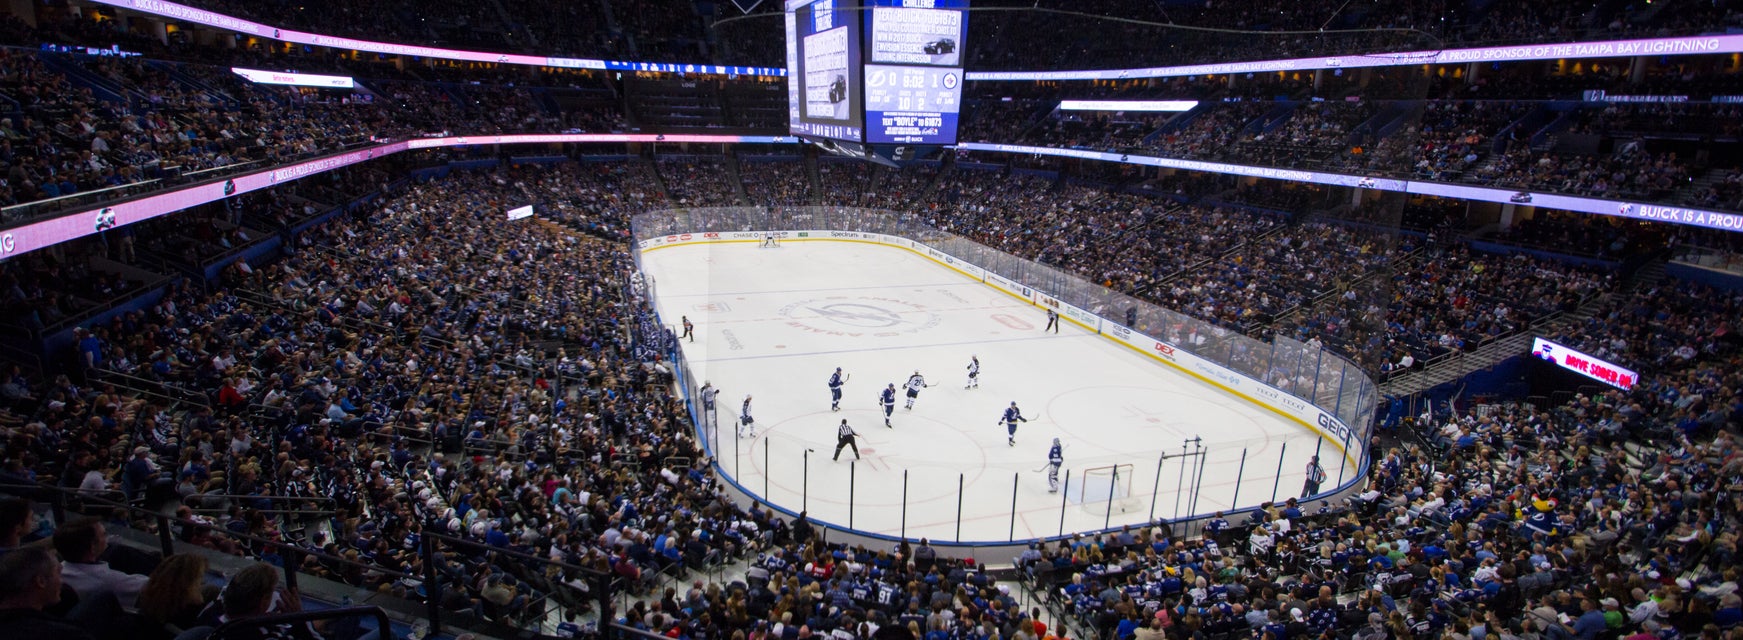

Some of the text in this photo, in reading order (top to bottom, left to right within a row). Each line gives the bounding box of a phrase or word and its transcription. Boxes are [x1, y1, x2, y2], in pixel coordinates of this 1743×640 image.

[878, 10, 894, 22] TEXT
[924, 13, 932, 24] TO
[934, 12, 956, 25] 61873
[936, 26, 949, 34] SHOT
[950, 26, 957, 35] TO
[893, 34, 906, 42] 2017
[901, 44, 922, 53] ESSENCE
[1438, 53, 1446, 61] A
[1449, 50, 1481, 60] PROUD
[1484, 48, 1531, 59] SPONSOR
[1534, 47, 1549, 57] OF
[1552, 45, 1572, 56] THE
[1575, 44, 1613, 55] TAMPA
[1617, 42, 1640, 53] BAY
[1644, 39, 1719, 52] LIGHTNING
[889, 72, 896, 86] 0
[932, 74, 938, 88] 1
[898, 97, 910, 110] 10
[918, 98, 924, 110] 2
[882, 118, 893, 126] TEXT
[925, 117, 942, 127] 61873
[1640, 206, 1680, 220] BUICK
[1683, 210, 1694, 222] IS
[1696, 212, 1704, 223] A
[1155, 342, 1175, 356] DEX
[1565, 354, 1590, 372] DRIVE
[1590, 363, 1618, 383] SOBER
[1256, 386, 1278, 398] TECO
[1283, 398, 1305, 410] TECO
[878, 590, 891, 604] 91
